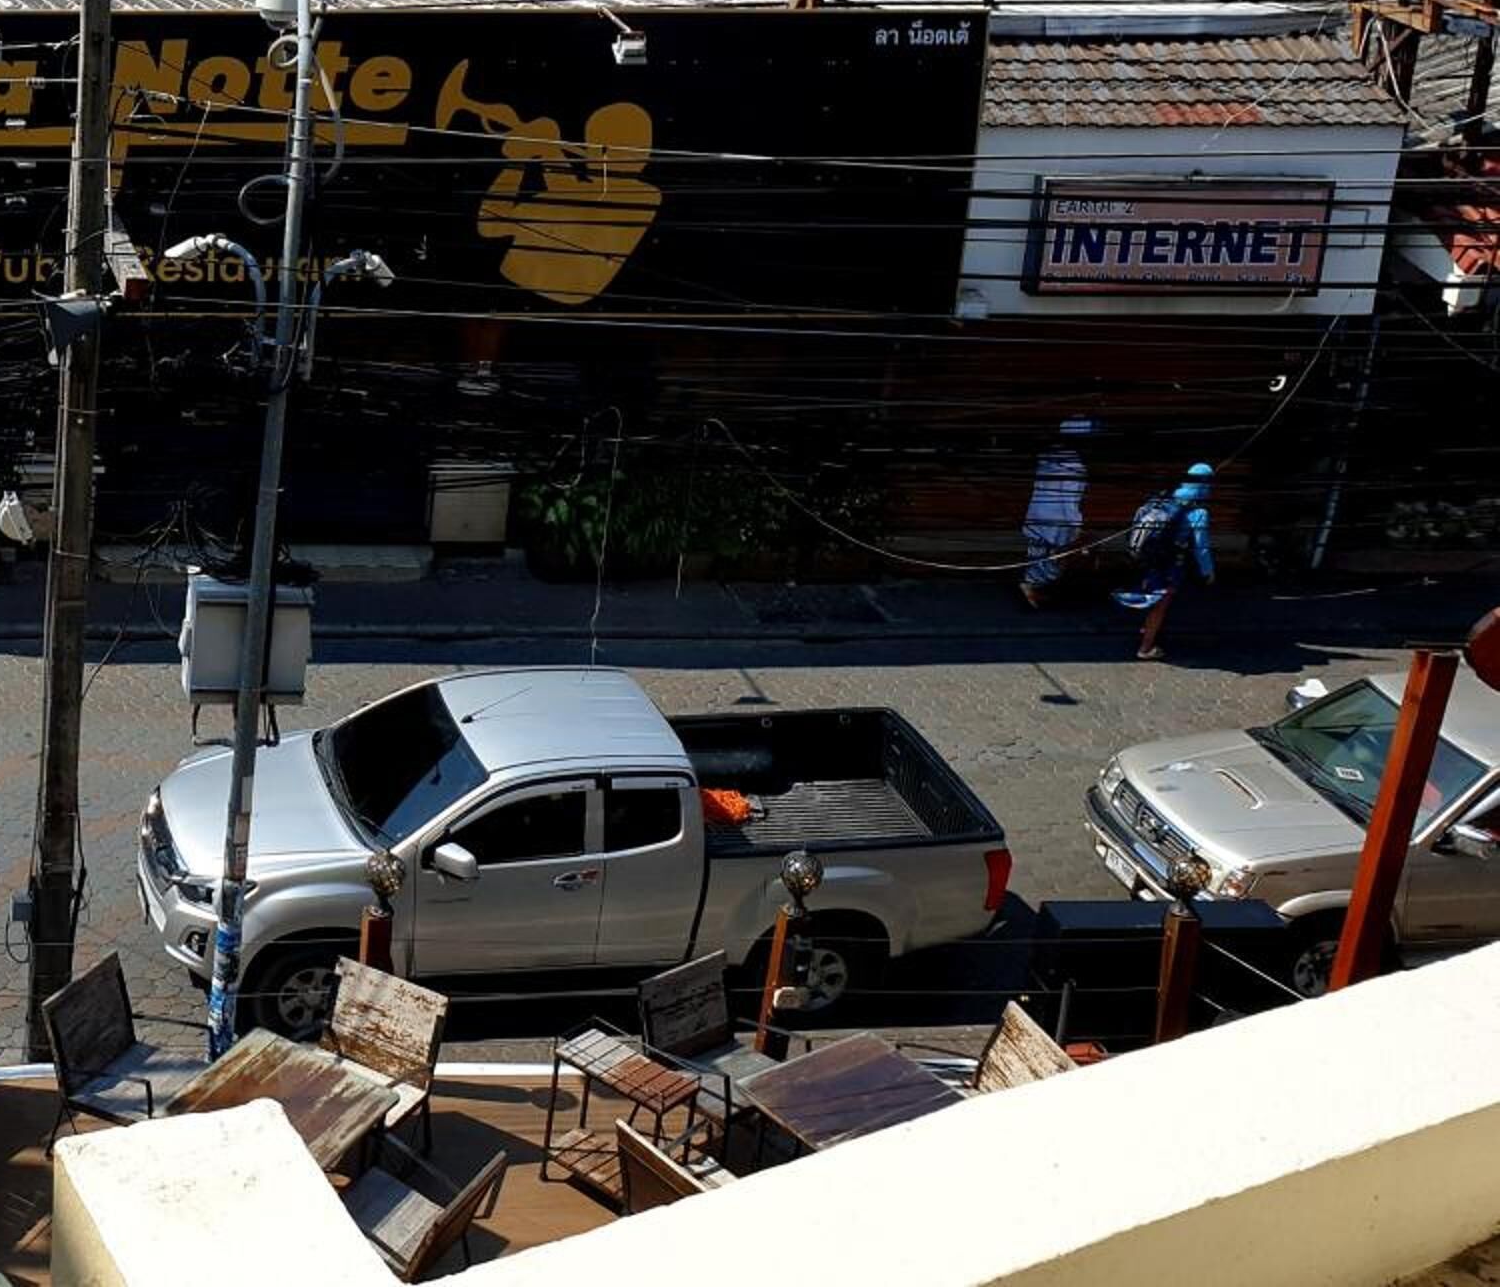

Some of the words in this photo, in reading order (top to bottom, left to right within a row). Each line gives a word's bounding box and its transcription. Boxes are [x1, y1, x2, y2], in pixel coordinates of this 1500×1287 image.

[111, 38, 414, 138] Notte
[1055, 199, 1111, 214] EARTH
[1049, 219, 1317, 266] INTERNET
